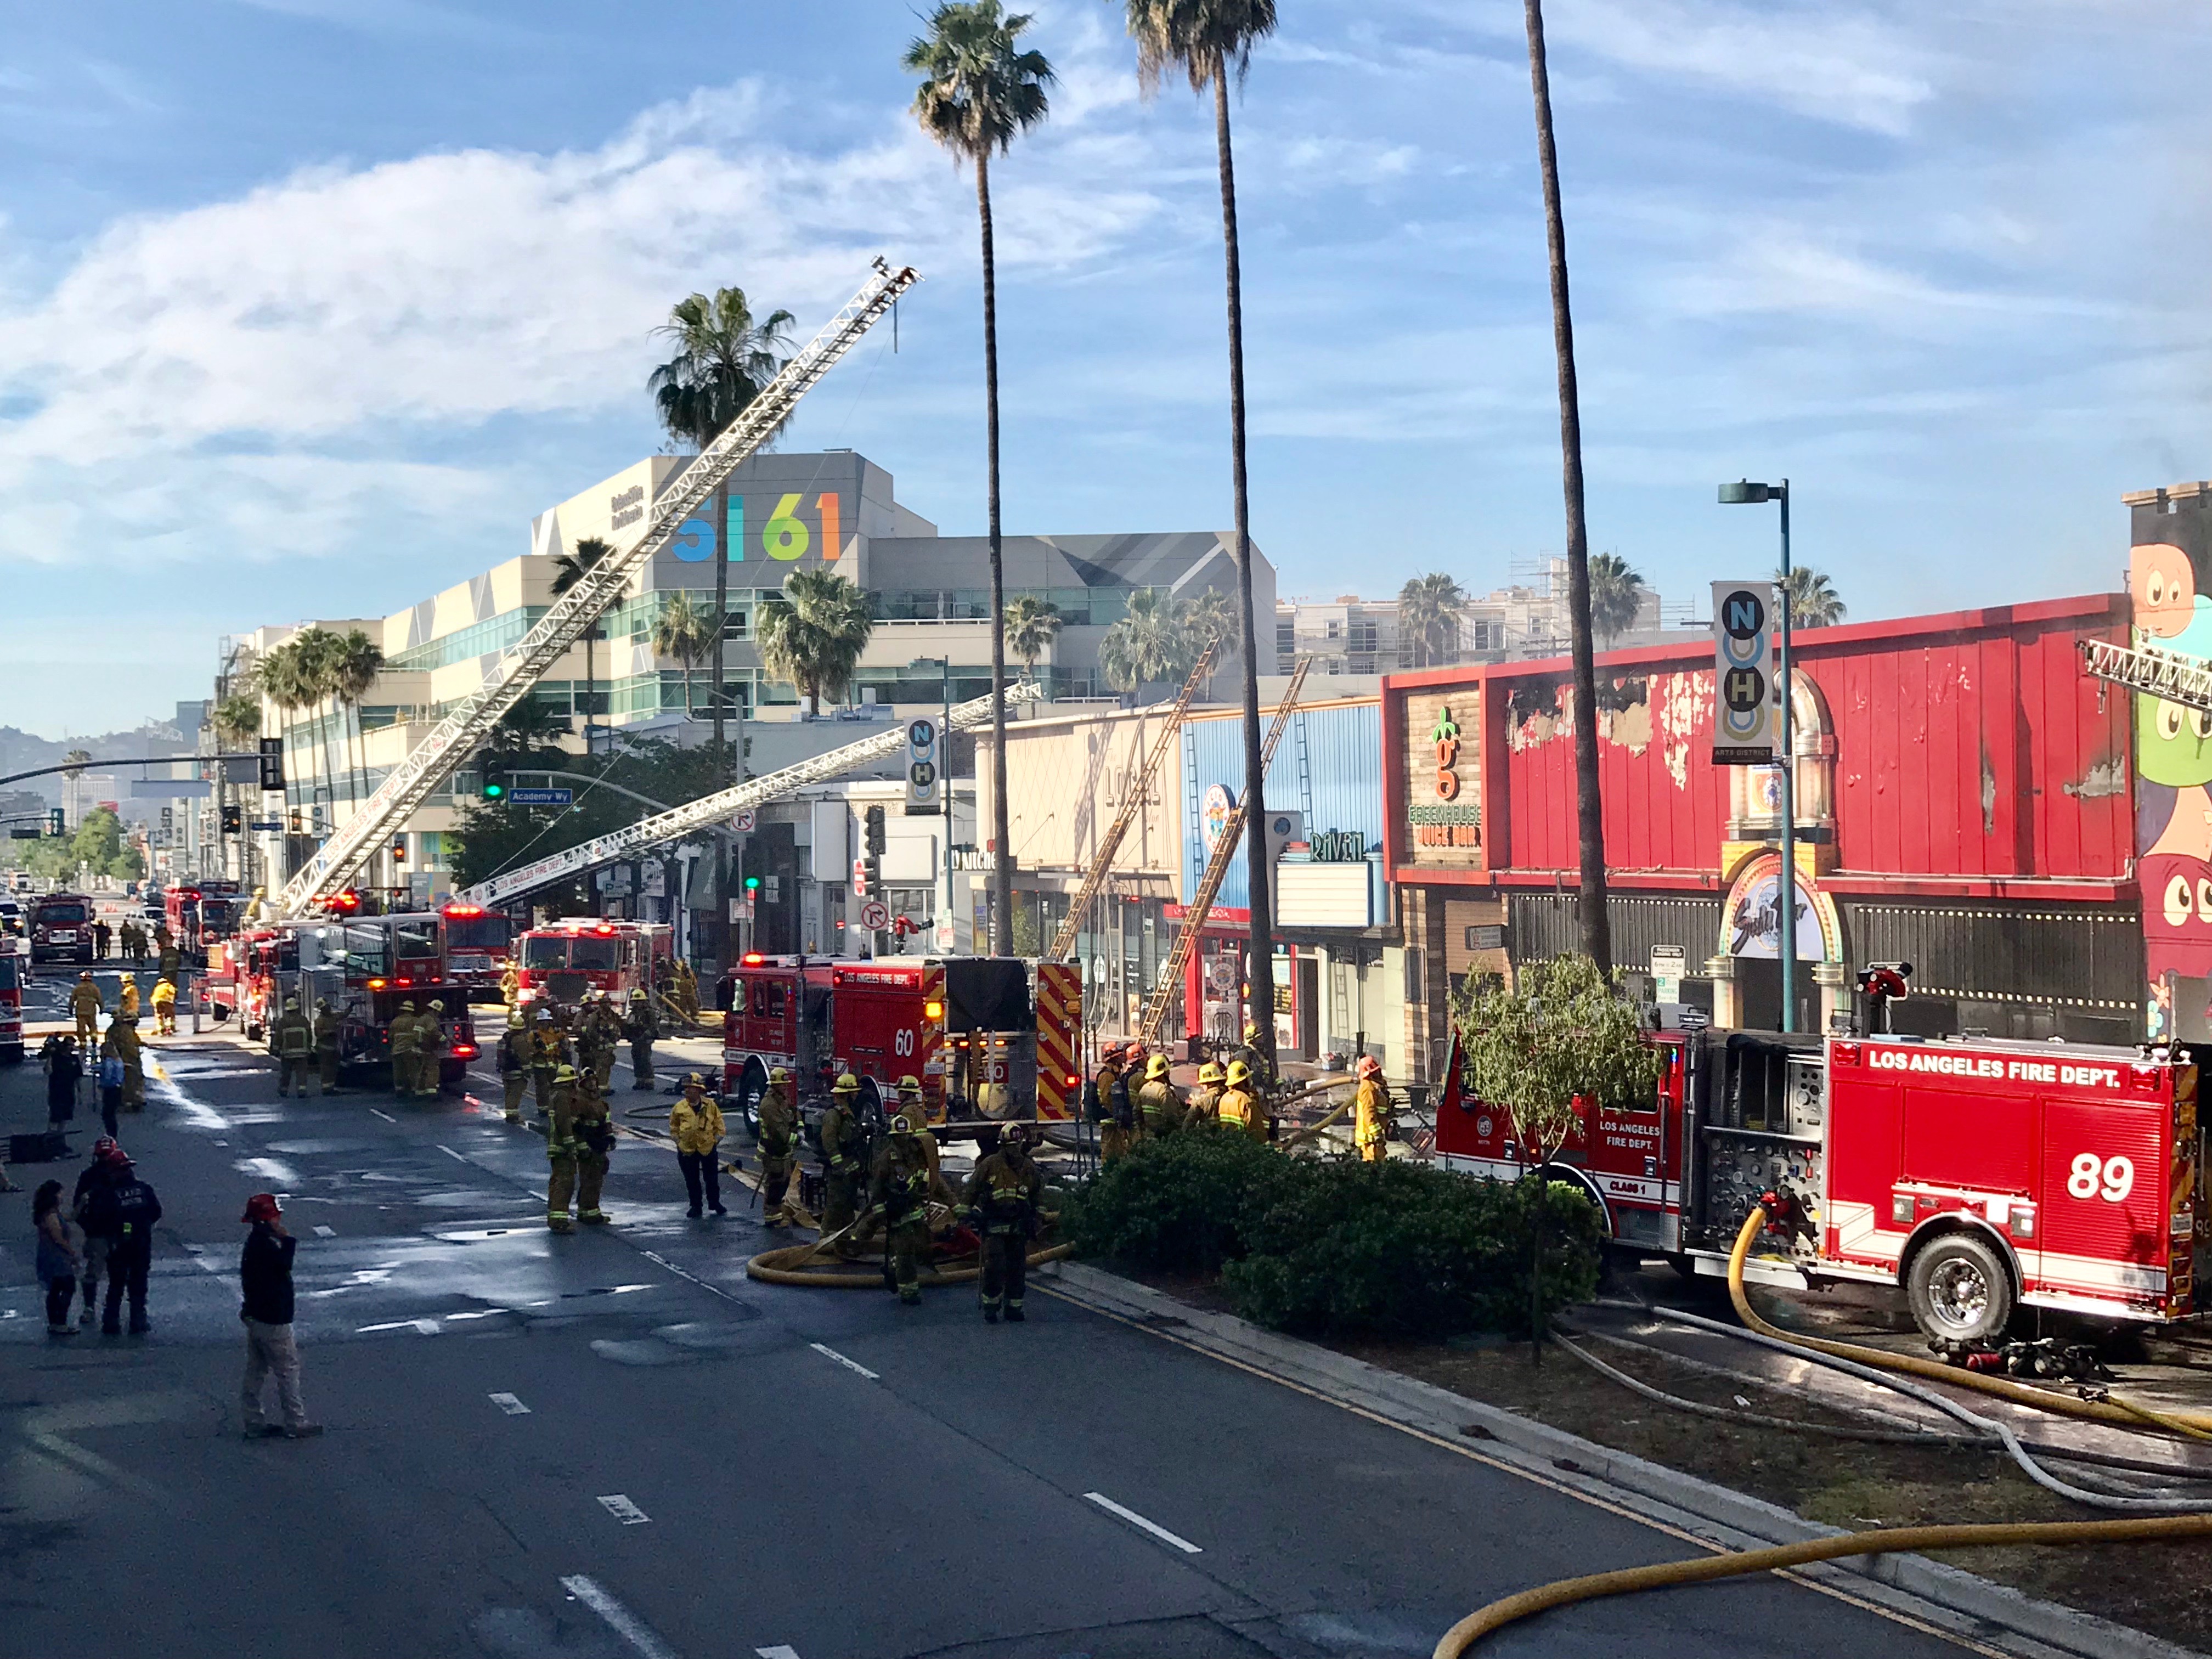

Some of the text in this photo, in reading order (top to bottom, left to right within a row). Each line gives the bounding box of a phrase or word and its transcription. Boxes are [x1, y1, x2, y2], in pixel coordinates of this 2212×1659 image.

[672, 493, 840, 562] 5161
[512, 792, 568, 802] Academy Wy
[340, 812, 368, 843] ANGELES
[368, 797, 383, 816] FIRE
[1408, 805, 1482, 823] GREENHOUSE
[1418, 825, 1476, 845] JUICE BAR
[1311, 832, 1364, 862] RAVEN
[497, 878, 508, 890] LOS
[510, 870, 534, 887] ANGELES
[535, 864, 547, 876] FIRE
[844, 973, 854, 983] LOS
[856, 973, 879, 984] ANGELES
[881, 973, 892, 984] FIRE
[895, 1028, 913, 1057] 60
[1869, 1051, 2121, 1088] LOS ANGELES FIRE DEPT.
[1600, 1121, 1660, 1136] LOS ANGELES
[1607, 1136, 1654, 1150] FIRE DEPT.
[1610, 1181, 1646, 1194] CLASS 1
[2067, 1153, 2135, 1203] 89
